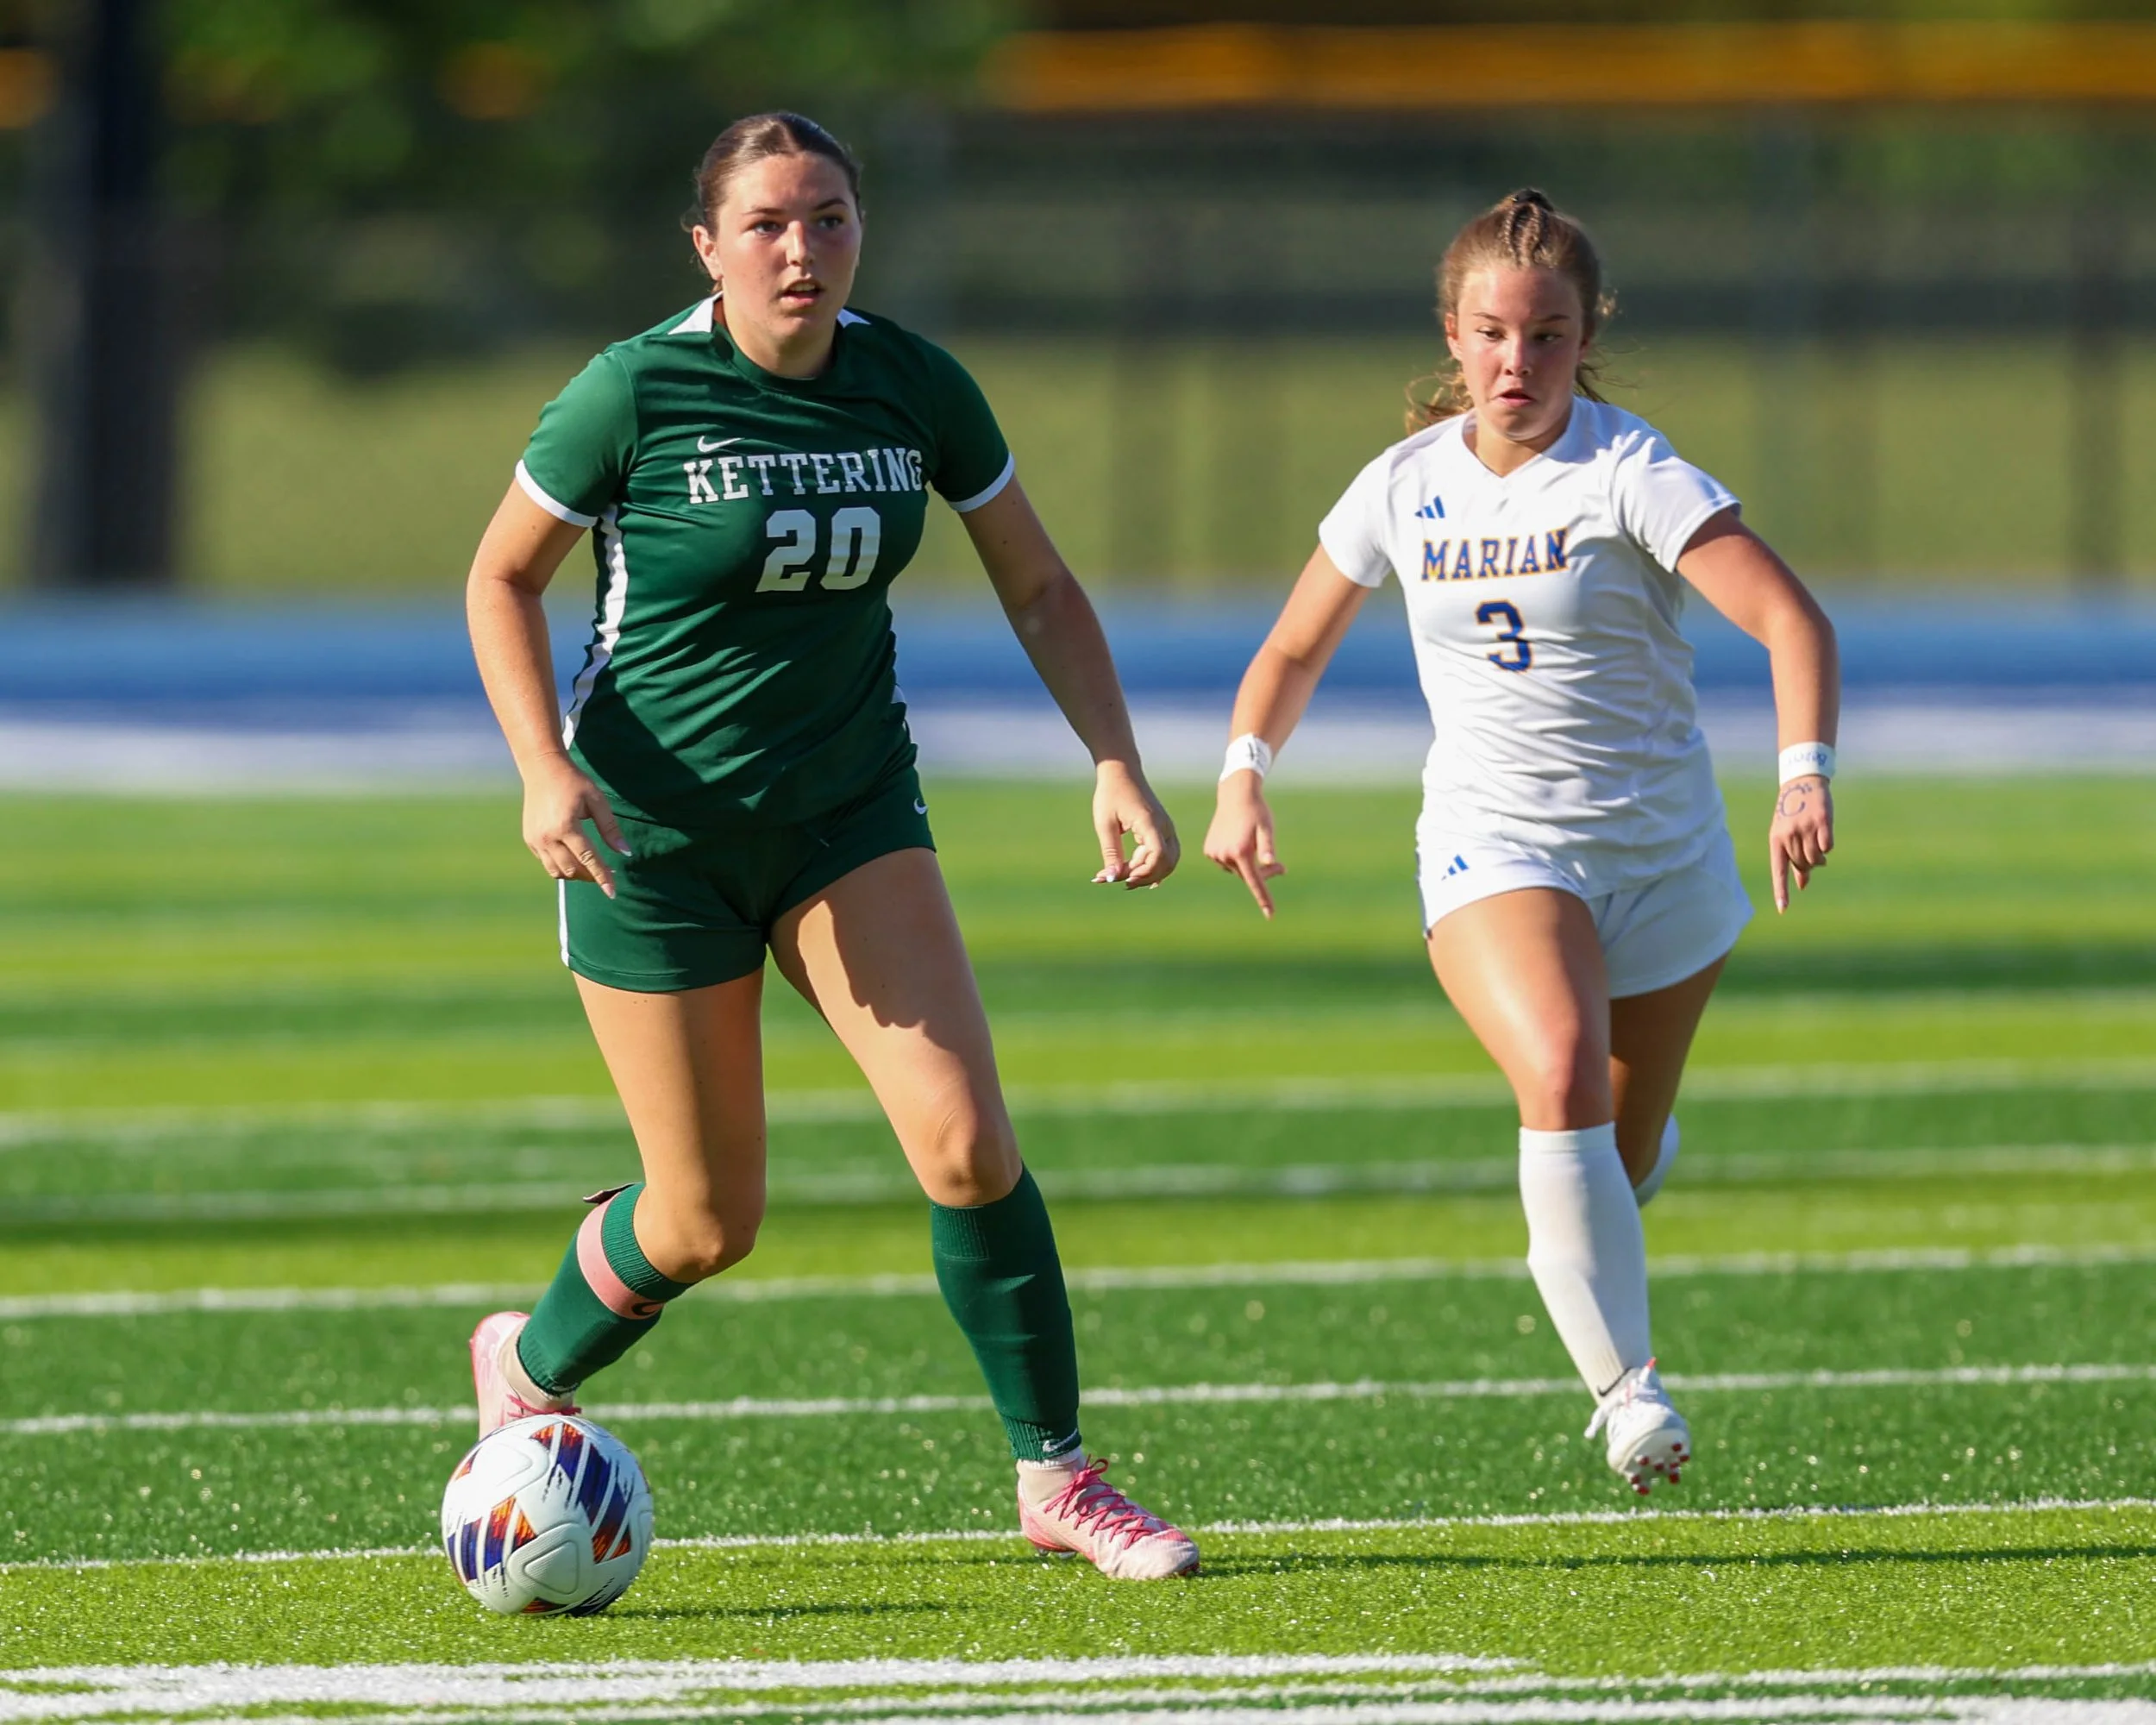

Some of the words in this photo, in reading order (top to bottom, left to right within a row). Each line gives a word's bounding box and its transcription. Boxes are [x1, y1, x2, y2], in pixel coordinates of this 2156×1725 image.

[683, 447, 923, 505] KETTERING
[755, 505, 881, 593] 20
[1420, 526, 1569, 582] MARIAN
[1475, 599, 1532, 674] 3
